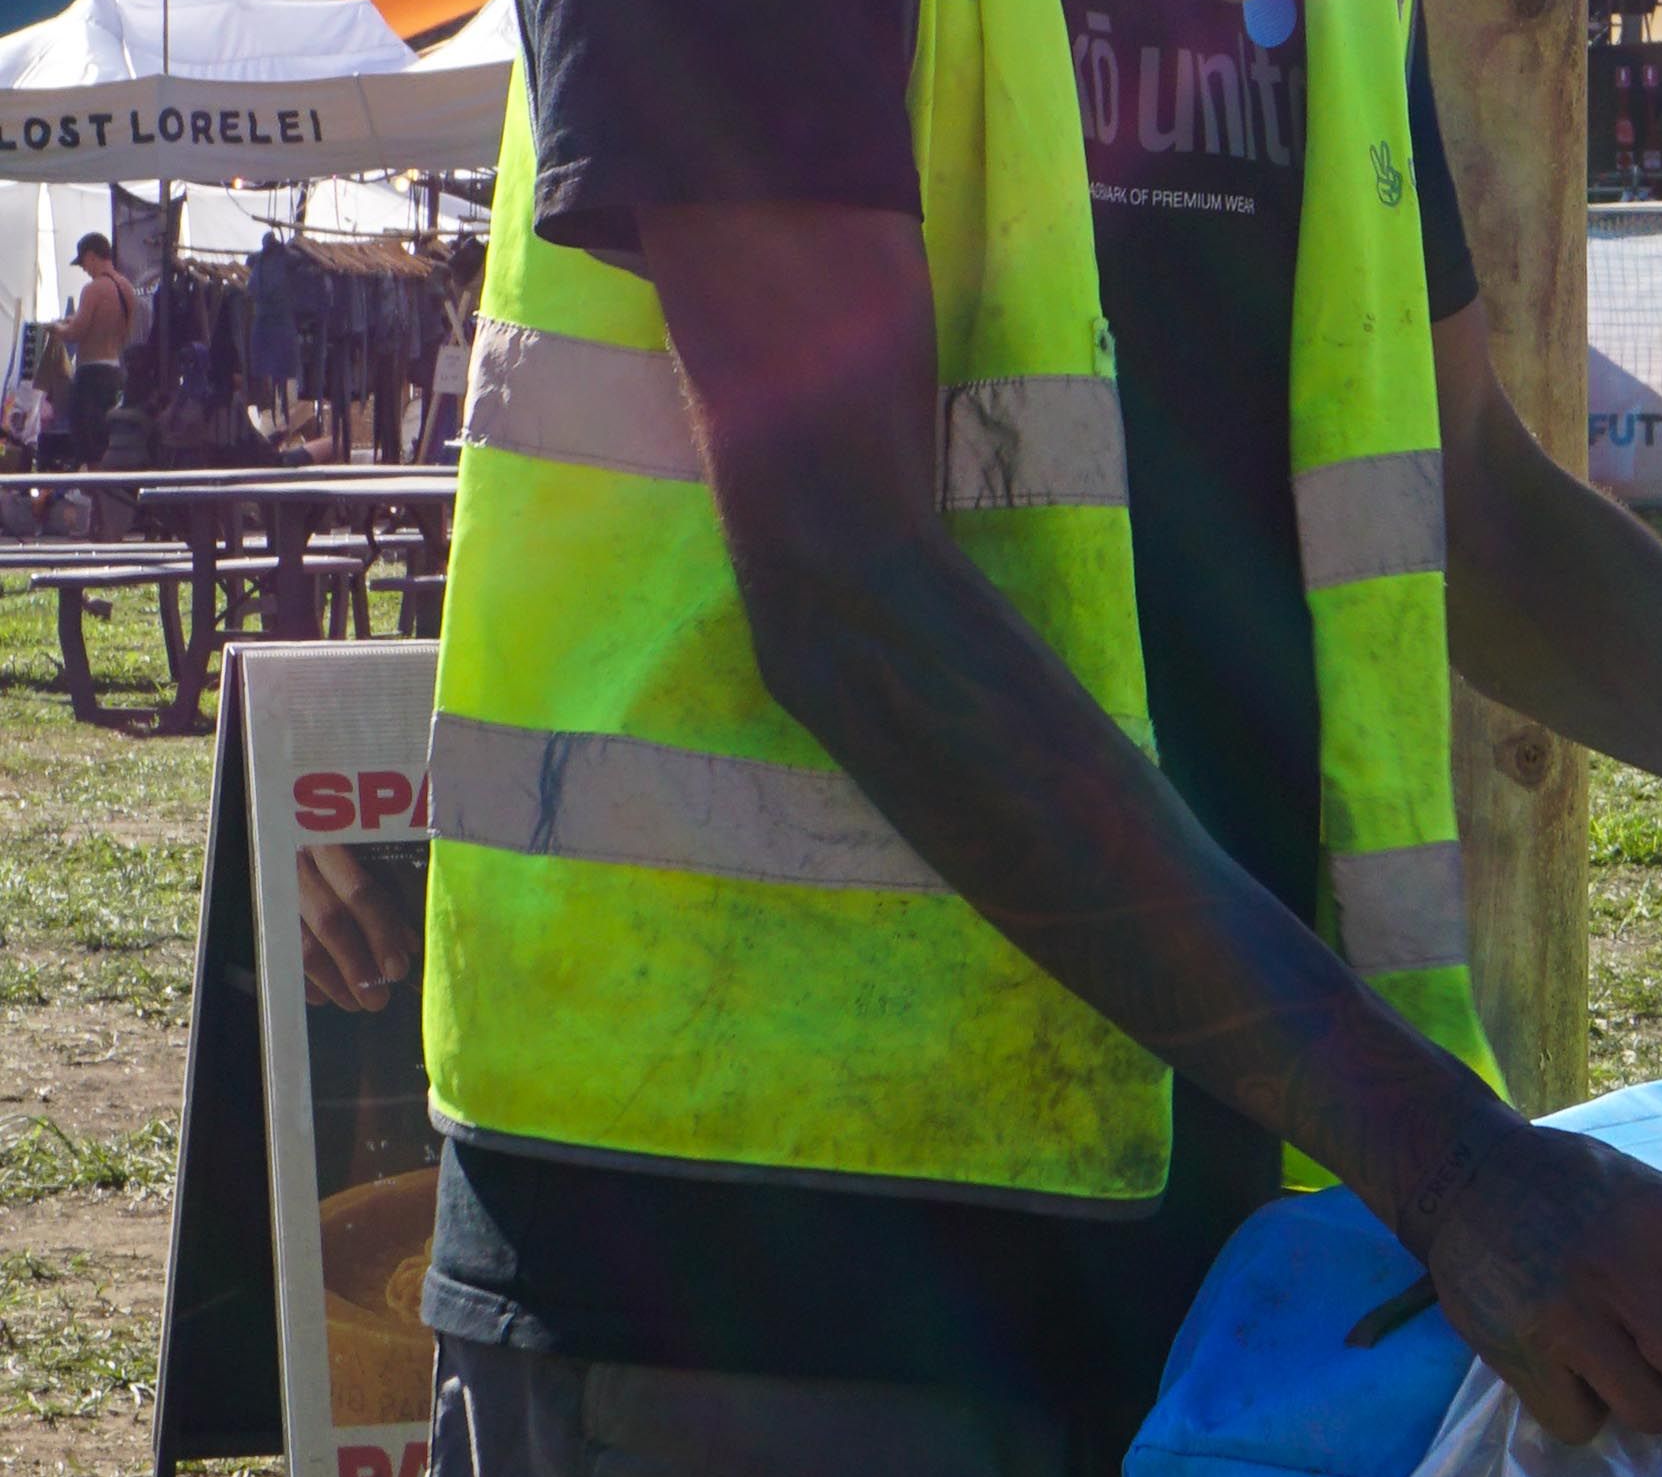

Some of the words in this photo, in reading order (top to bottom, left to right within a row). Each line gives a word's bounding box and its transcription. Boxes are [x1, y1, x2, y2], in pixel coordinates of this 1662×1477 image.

[0, 115, 113, 150] LOST
[130, 107, 322, 145] LORELEI
[1130, 188, 1149, 206] OF
[1152, 190, 1222, 212] PREMIUM
[1225, 195, 1256, 214] WEAR
